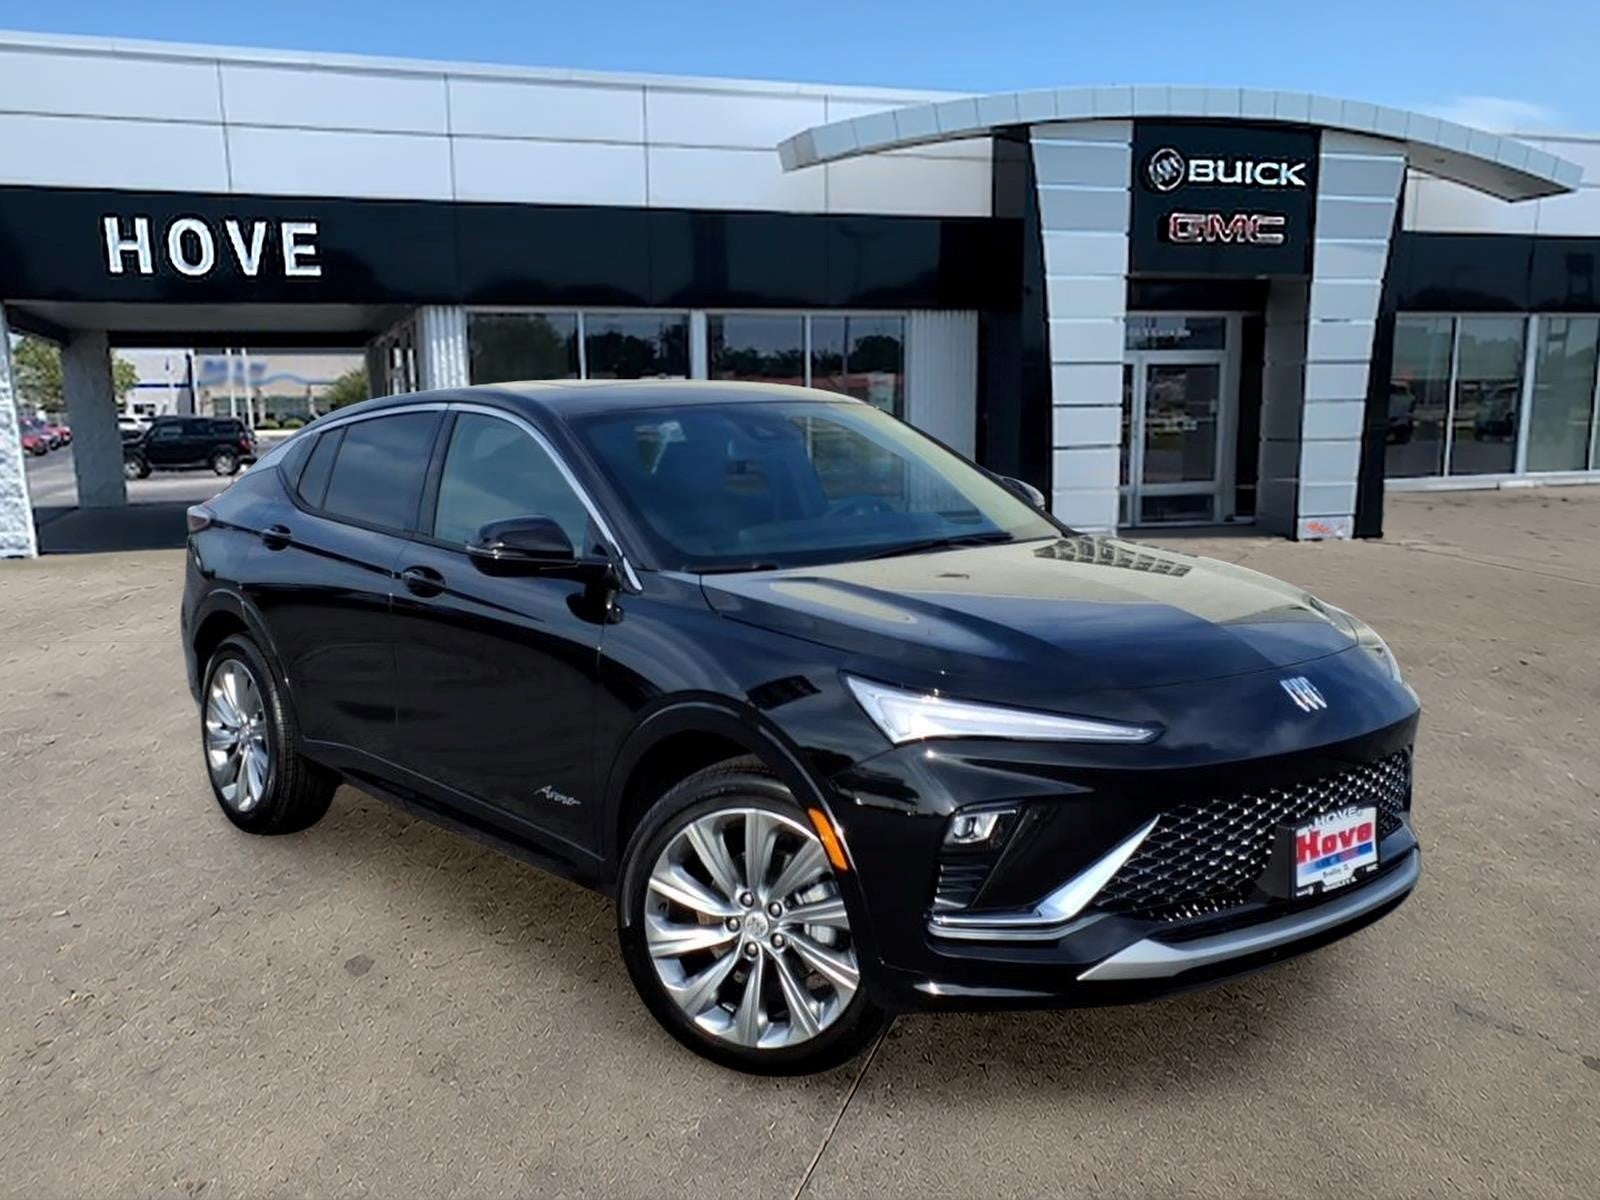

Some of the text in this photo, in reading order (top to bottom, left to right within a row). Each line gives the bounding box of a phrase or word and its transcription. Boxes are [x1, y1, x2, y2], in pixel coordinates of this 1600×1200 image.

[1188, 159, 1306, 186] BUICK
[104, 216, 322, 276] HOVE
[1168, 212, 1285, 244] GMC
[1296, 821, 1373, 865] Hove
